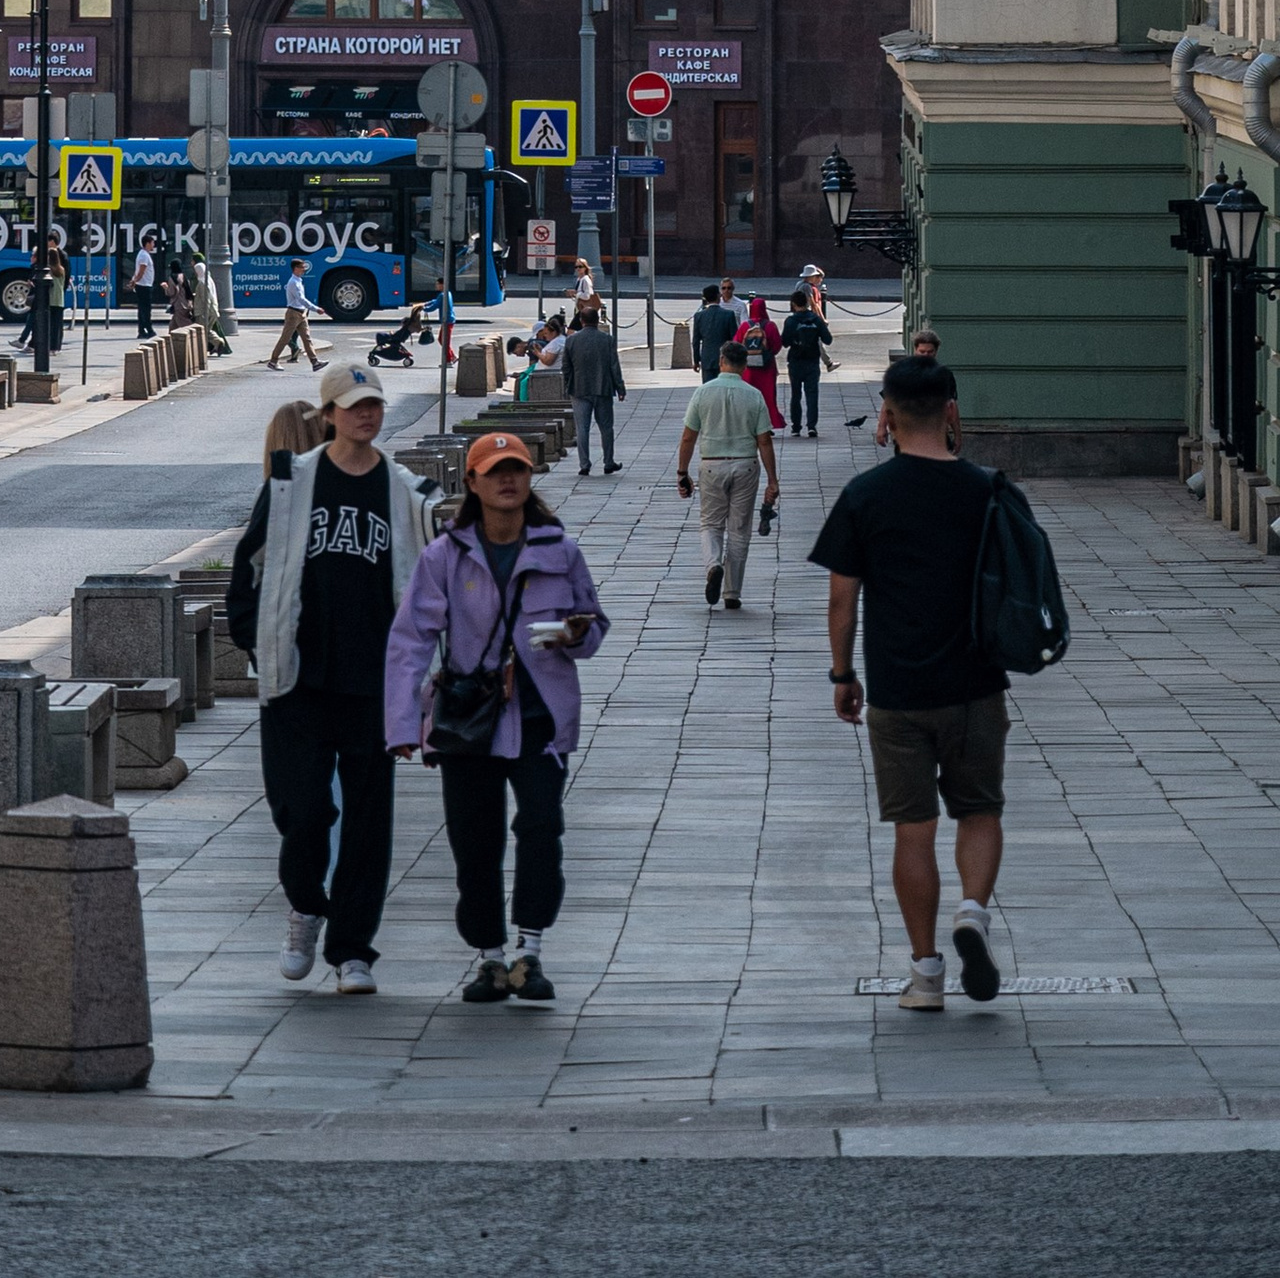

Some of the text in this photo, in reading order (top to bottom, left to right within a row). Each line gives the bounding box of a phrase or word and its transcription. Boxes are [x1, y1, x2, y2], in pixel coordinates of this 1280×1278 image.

[275, 34, 461, 55] СТРАНА КОТОРОЙ НЕТ
[658, 47, 729, 58] РЕСТОРАН
[677, 60, 711, 70] КАФЕ
[276, 110, 310, 118] РЕСТОРАН
[345, 111, 363, 119] КАФЕ
[81, 210, 393, 264] элекробус.
[250, 256, 287, 267] 411336
[235, 273, 280, 283] привязан
[233, 282, 282, 292] онтактной
[495, 436, 507, 449] D
[306, 505, 391, 564] GAP
